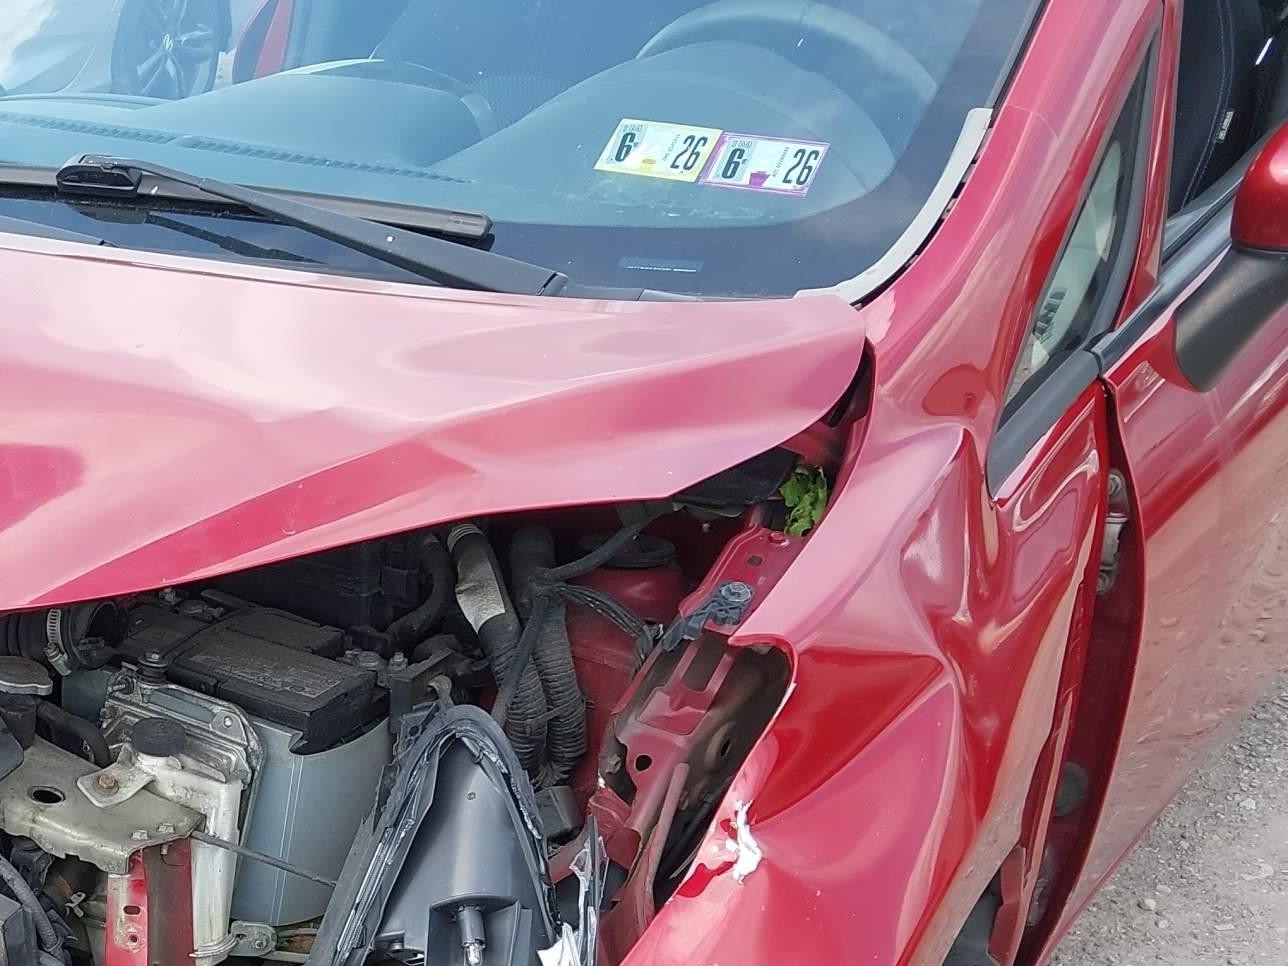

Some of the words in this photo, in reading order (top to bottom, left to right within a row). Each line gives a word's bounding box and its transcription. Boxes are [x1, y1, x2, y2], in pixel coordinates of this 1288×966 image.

[614, 132, 636, 162] 6
[670, 134, 708, 171] 26
[721, 148, 745, 179] 6
[782, 148, 820, 186] 26
